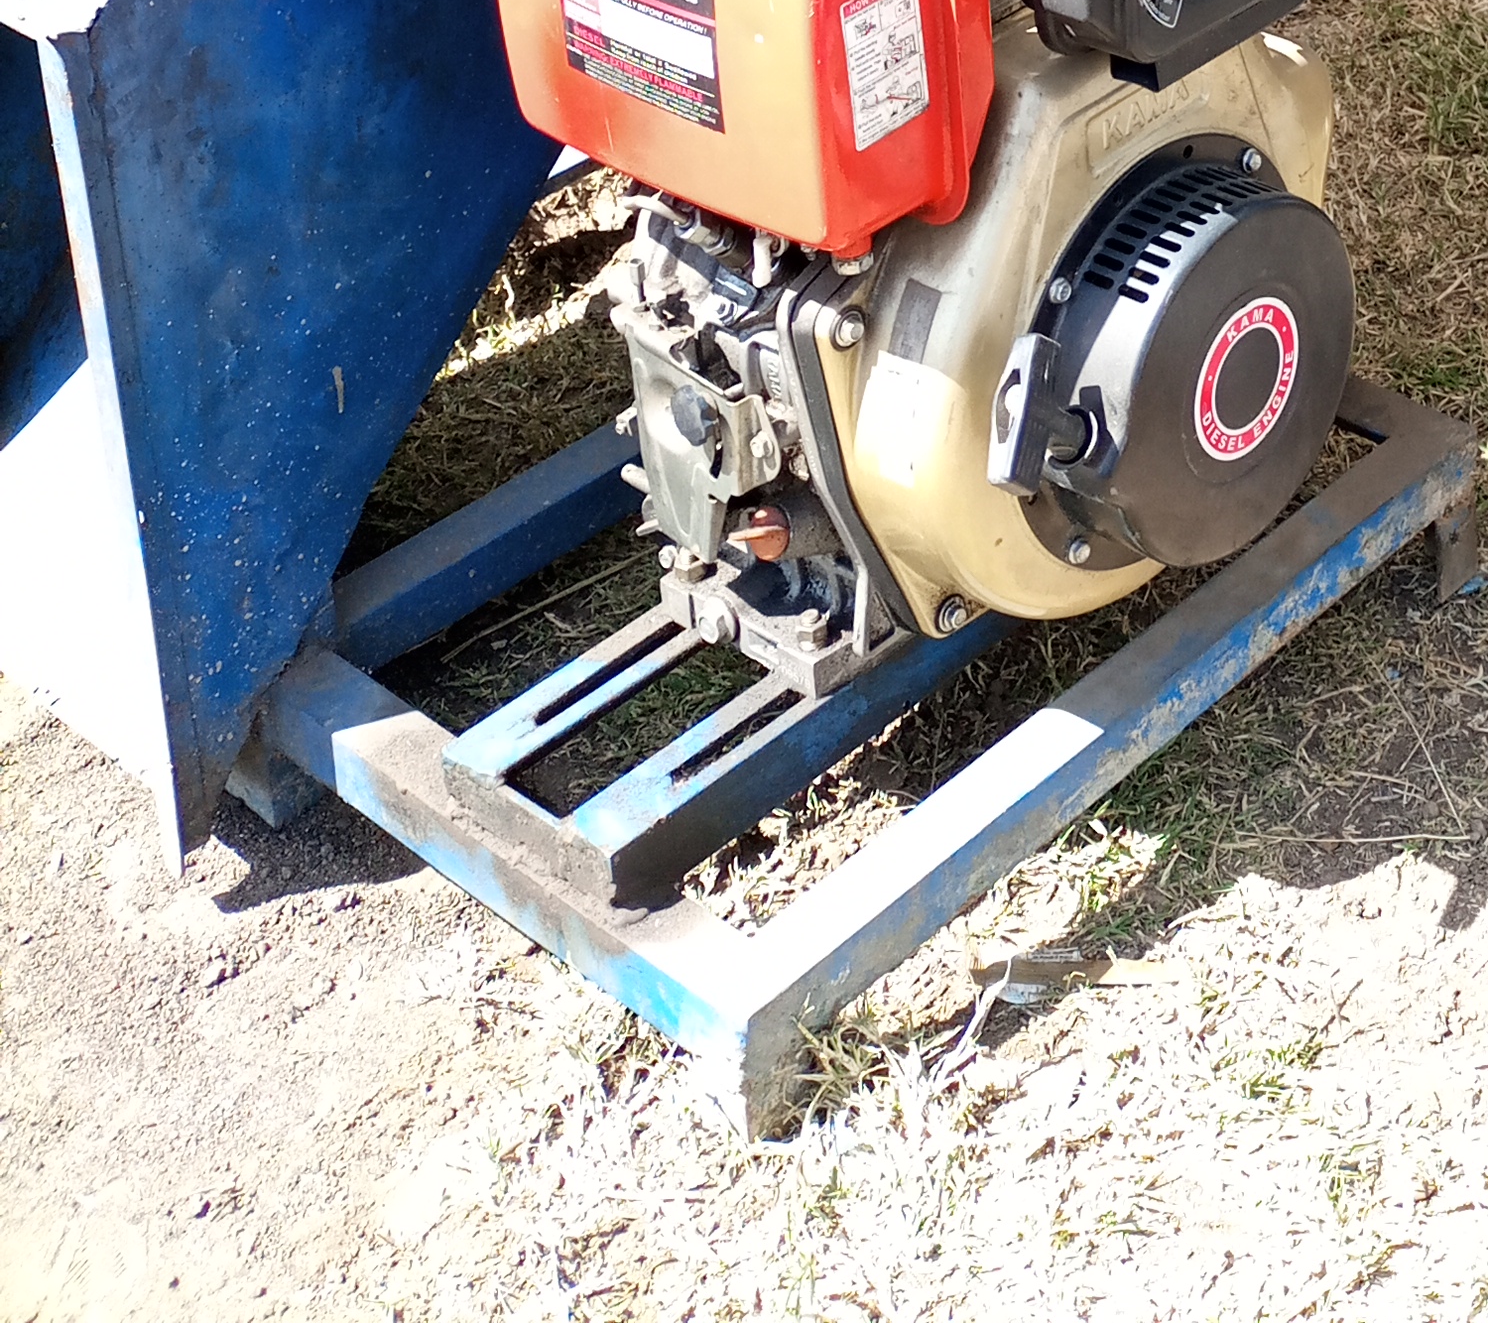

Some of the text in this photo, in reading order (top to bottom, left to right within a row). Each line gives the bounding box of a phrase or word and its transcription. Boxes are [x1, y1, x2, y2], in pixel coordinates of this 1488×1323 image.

[573, 25, 606, 49] DIESEL
[654, 73, 704, 103] FLAMMABLE
[1225, 307, 1275, 342] KAMA
[1202, 350, 1294, 451] DIESEL ENGINE
